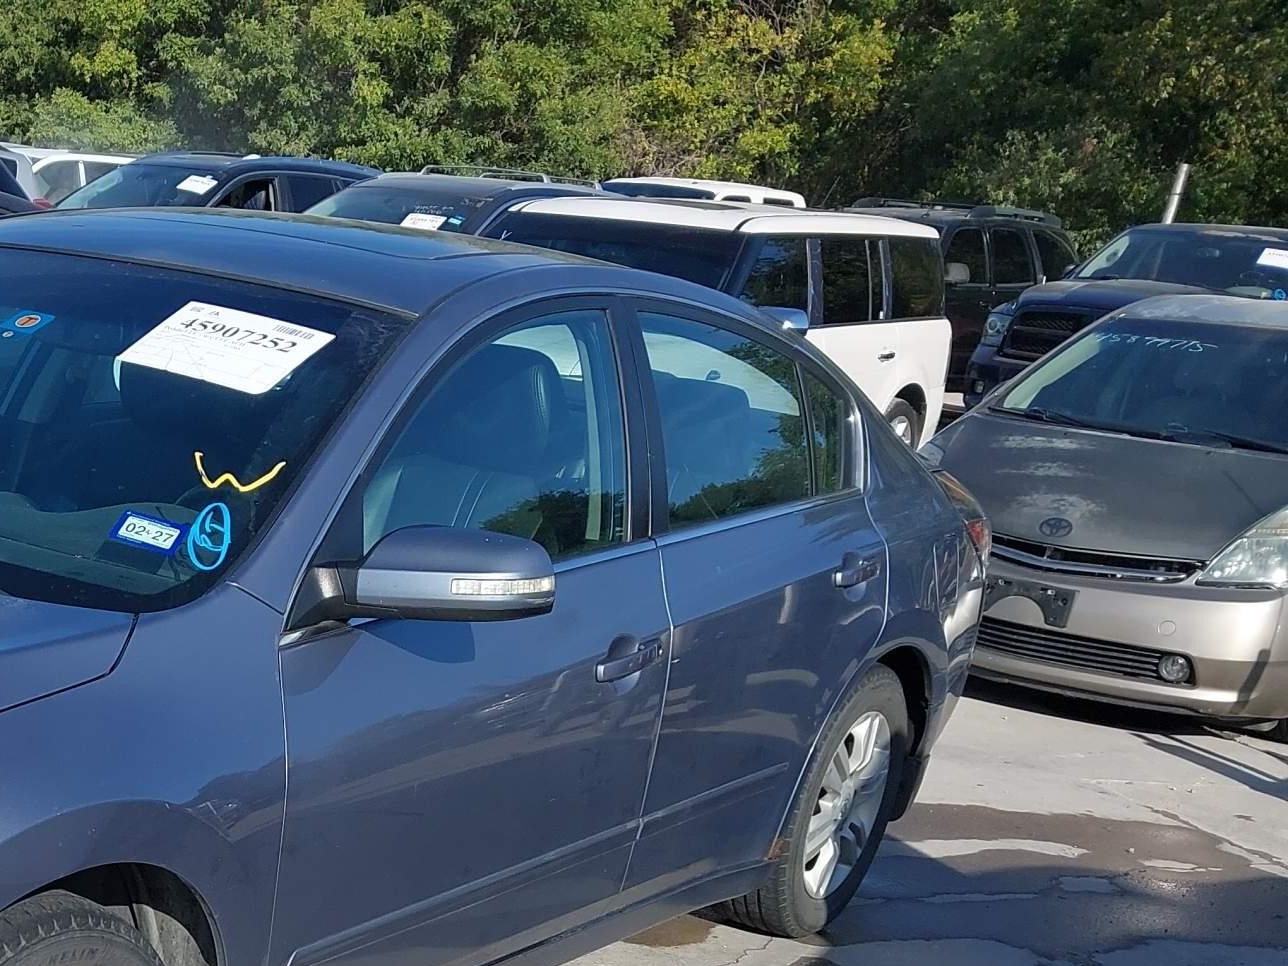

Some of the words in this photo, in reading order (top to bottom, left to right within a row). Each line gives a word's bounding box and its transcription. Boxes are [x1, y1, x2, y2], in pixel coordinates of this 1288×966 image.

[180, 318, 298, 353] 45907252
[125, 522, 147, 536] 02
[151, 530, 174, 543] 27
